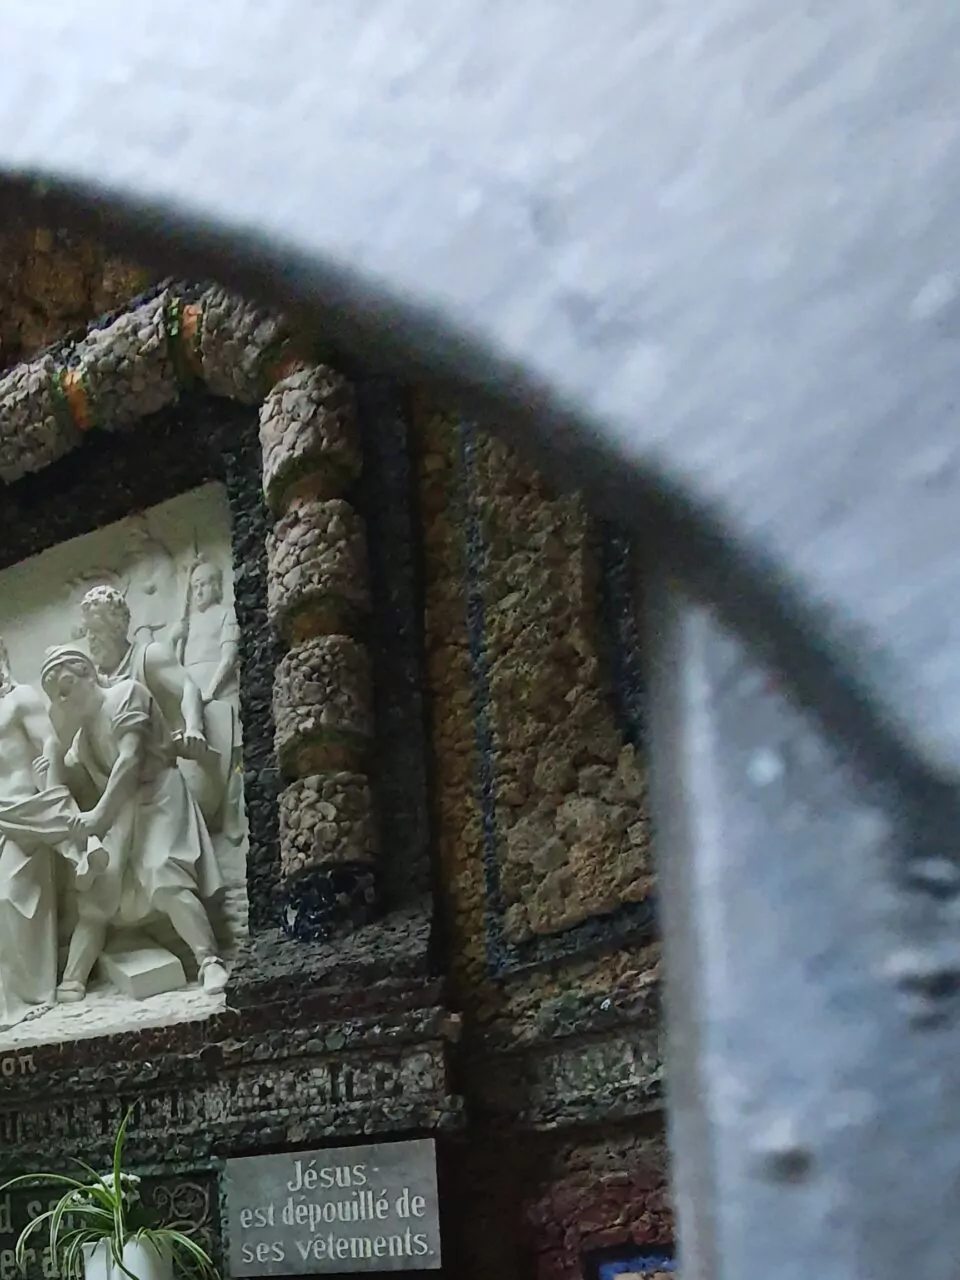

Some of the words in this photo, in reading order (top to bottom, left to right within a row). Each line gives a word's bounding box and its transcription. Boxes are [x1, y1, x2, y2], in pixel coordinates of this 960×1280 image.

[286, 1159, 368, 1192] Jésus
[239, 1202, 275, 1229] est
[281, 1189, 390, 1233] dépouillé
[395, 1187, 427, 1219] de
[241, 1240, 286, 1264] ses
[296, 1226, 435, 1261] vêtements.
